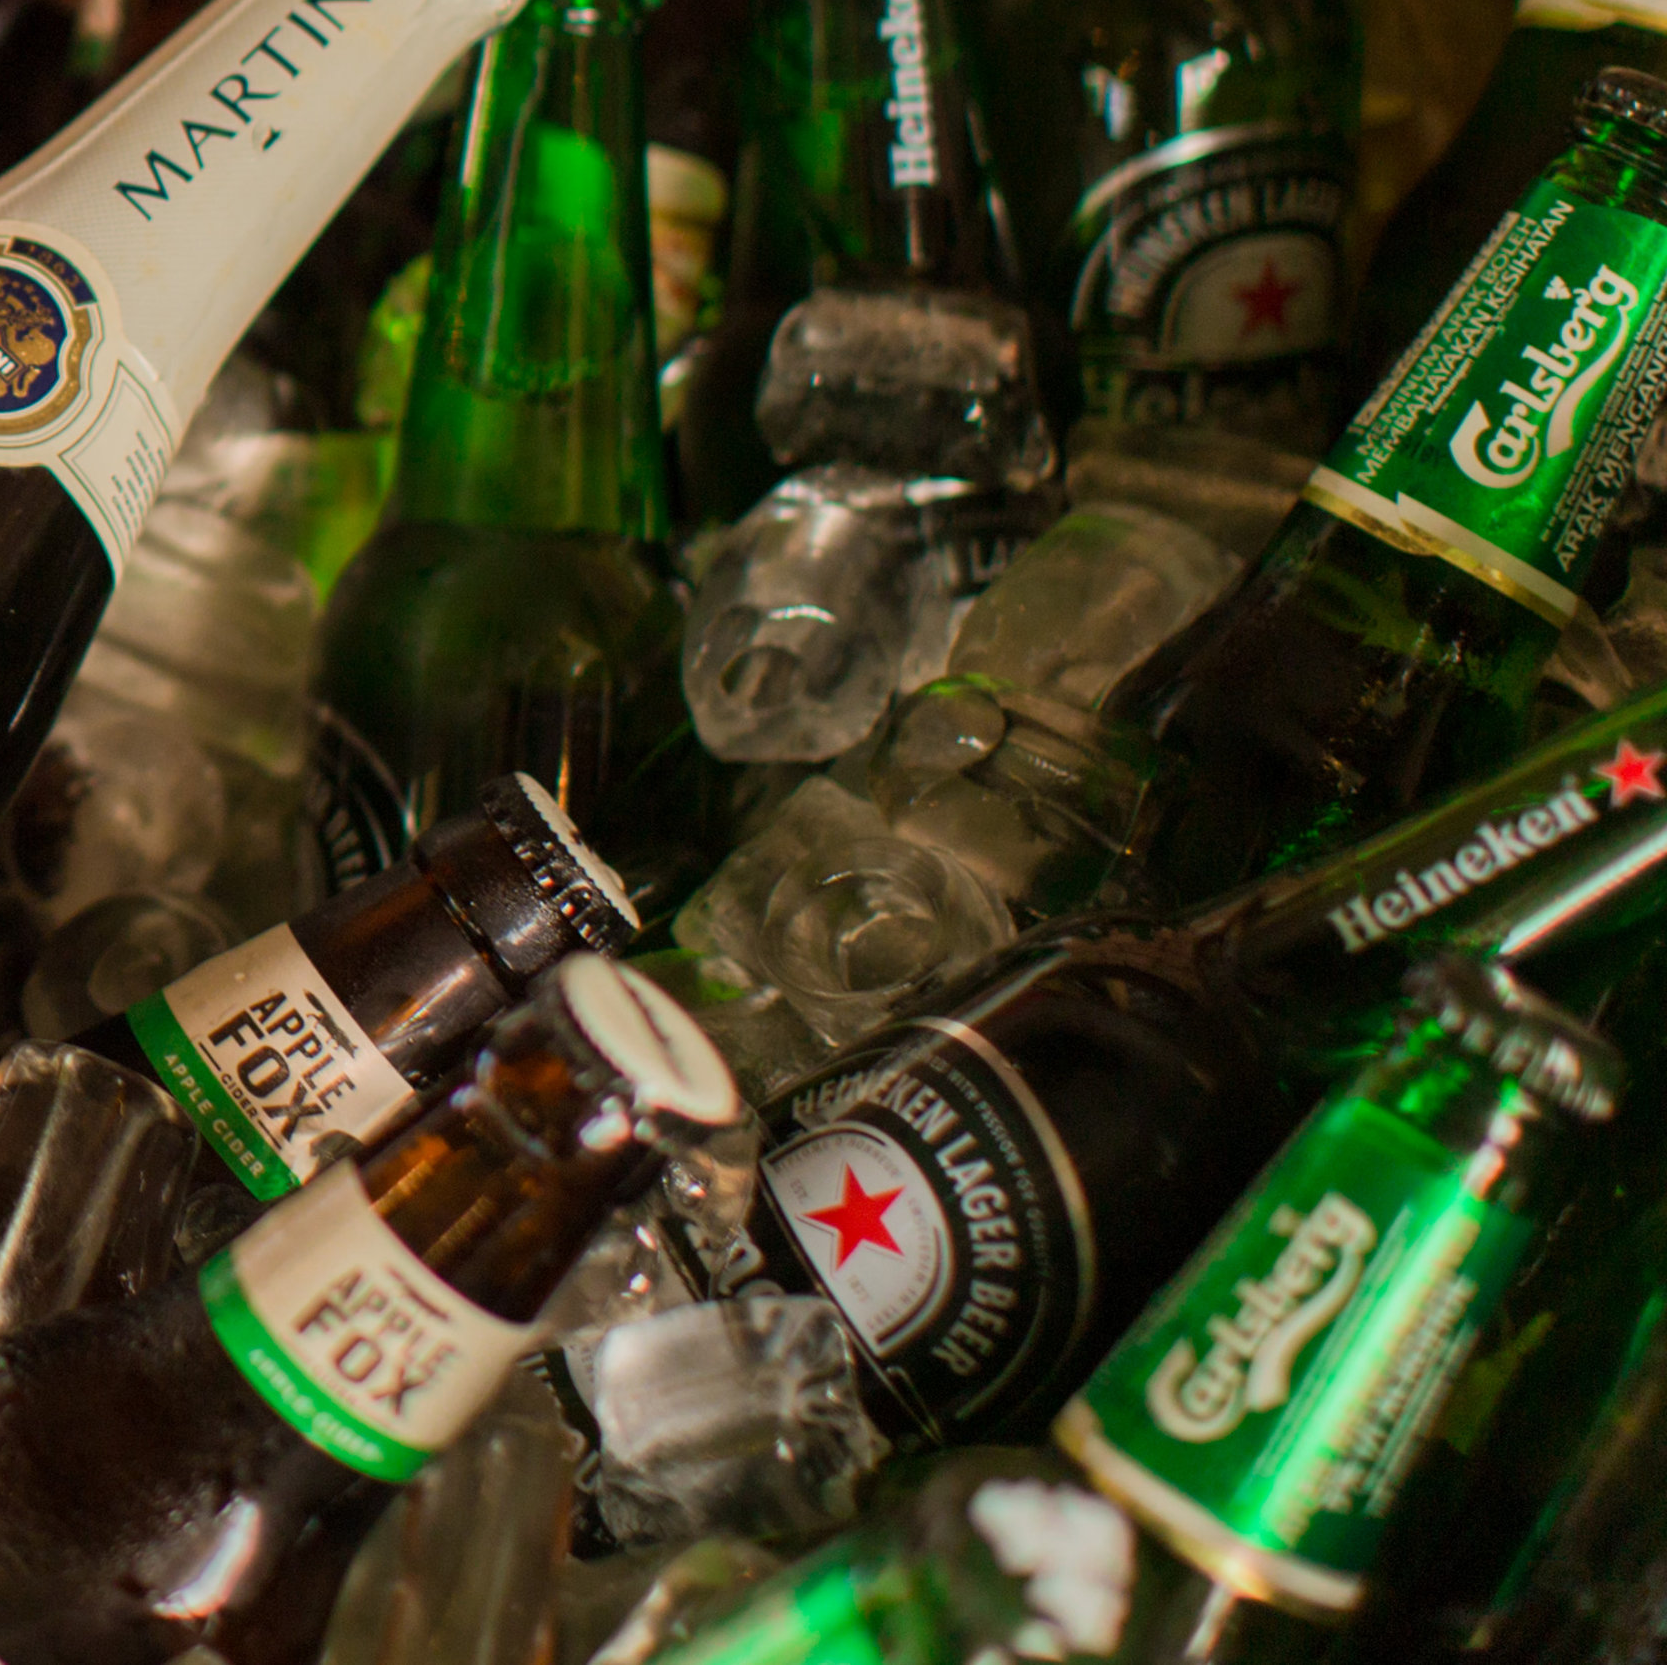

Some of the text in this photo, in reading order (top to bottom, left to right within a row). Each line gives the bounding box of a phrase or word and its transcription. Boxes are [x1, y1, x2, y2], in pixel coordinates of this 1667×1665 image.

[1483, 198, 1576, 318] KESIHATAN
[1354, 341, 1446, 457] MEMINUM
[1439, 284, 1489, 347] ARAK
[1480, 215, 1538, 289] BOLEH
[1447, 261, 1641, 491] Carlsberg
[1325, 773, 1600, 954] Heineken
[207, 1009, 325, 1143] FOX
[219, 1073, 258, 1121] CIDER
[249, 990, 357, 1111] APPLE
[164, 1052, 267, 1181] APPLE CIDER
[934, 1131, 1021, 1271] LAGER
[291, 1297, 427, 1417] FOX
[930, 1277, 1021, 1379] BEER
